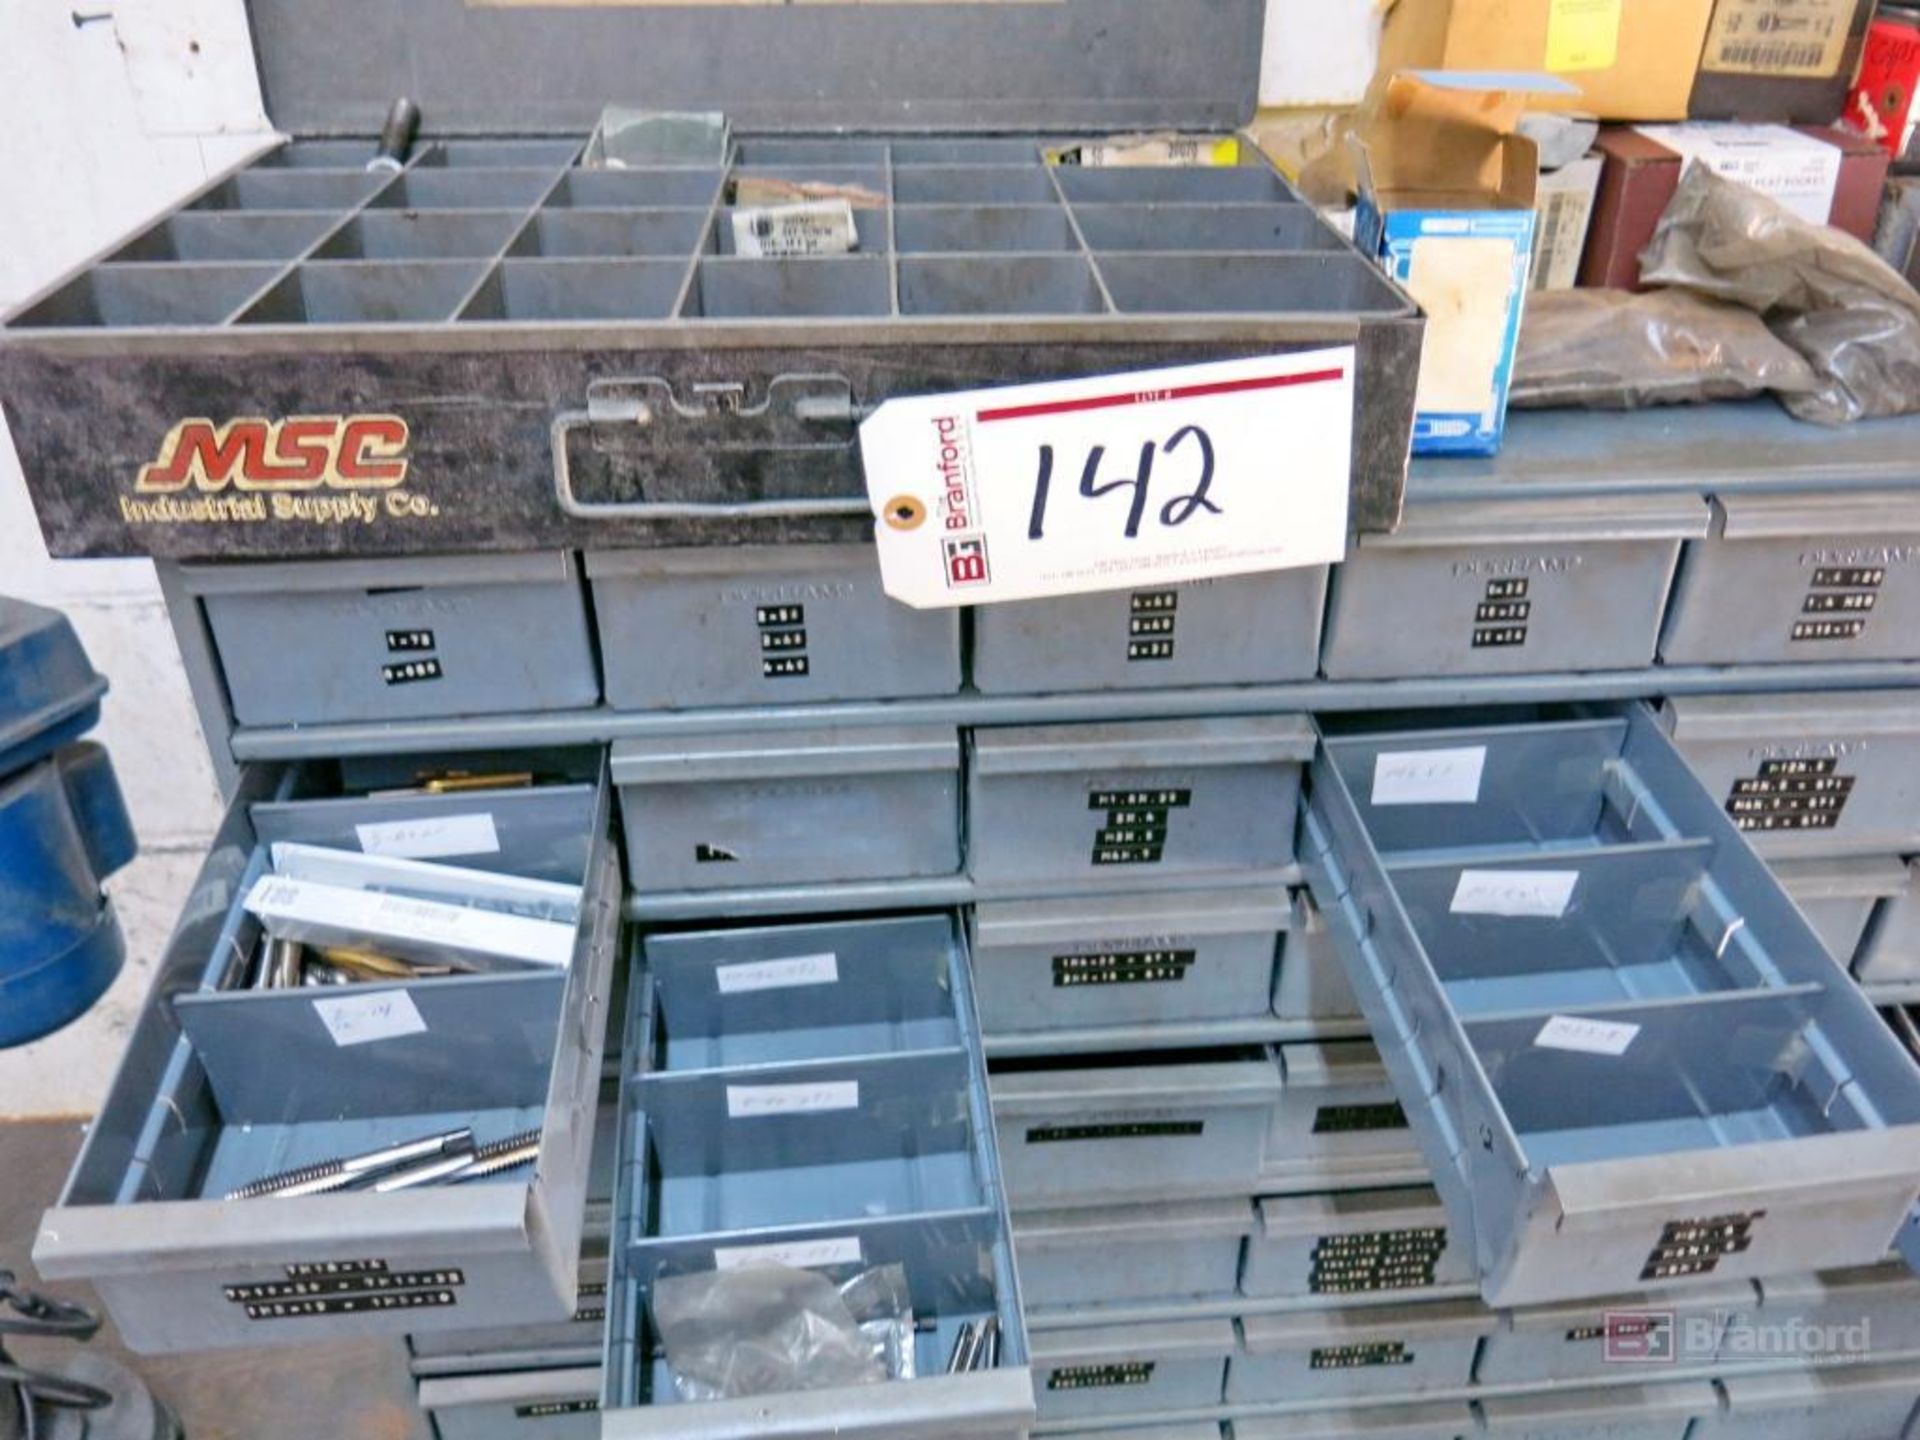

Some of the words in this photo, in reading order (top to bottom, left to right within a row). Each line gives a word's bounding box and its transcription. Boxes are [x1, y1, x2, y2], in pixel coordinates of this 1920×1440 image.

[134, 413, 409, 493] MSC
[930, 416, 968, 531] Branford
[1028, 424, 1224, 541] 142
[119, 494, 266, 523] Industrial
[271, 492, 377, 523] Supply
[385, 491, 440, 517] Co.
